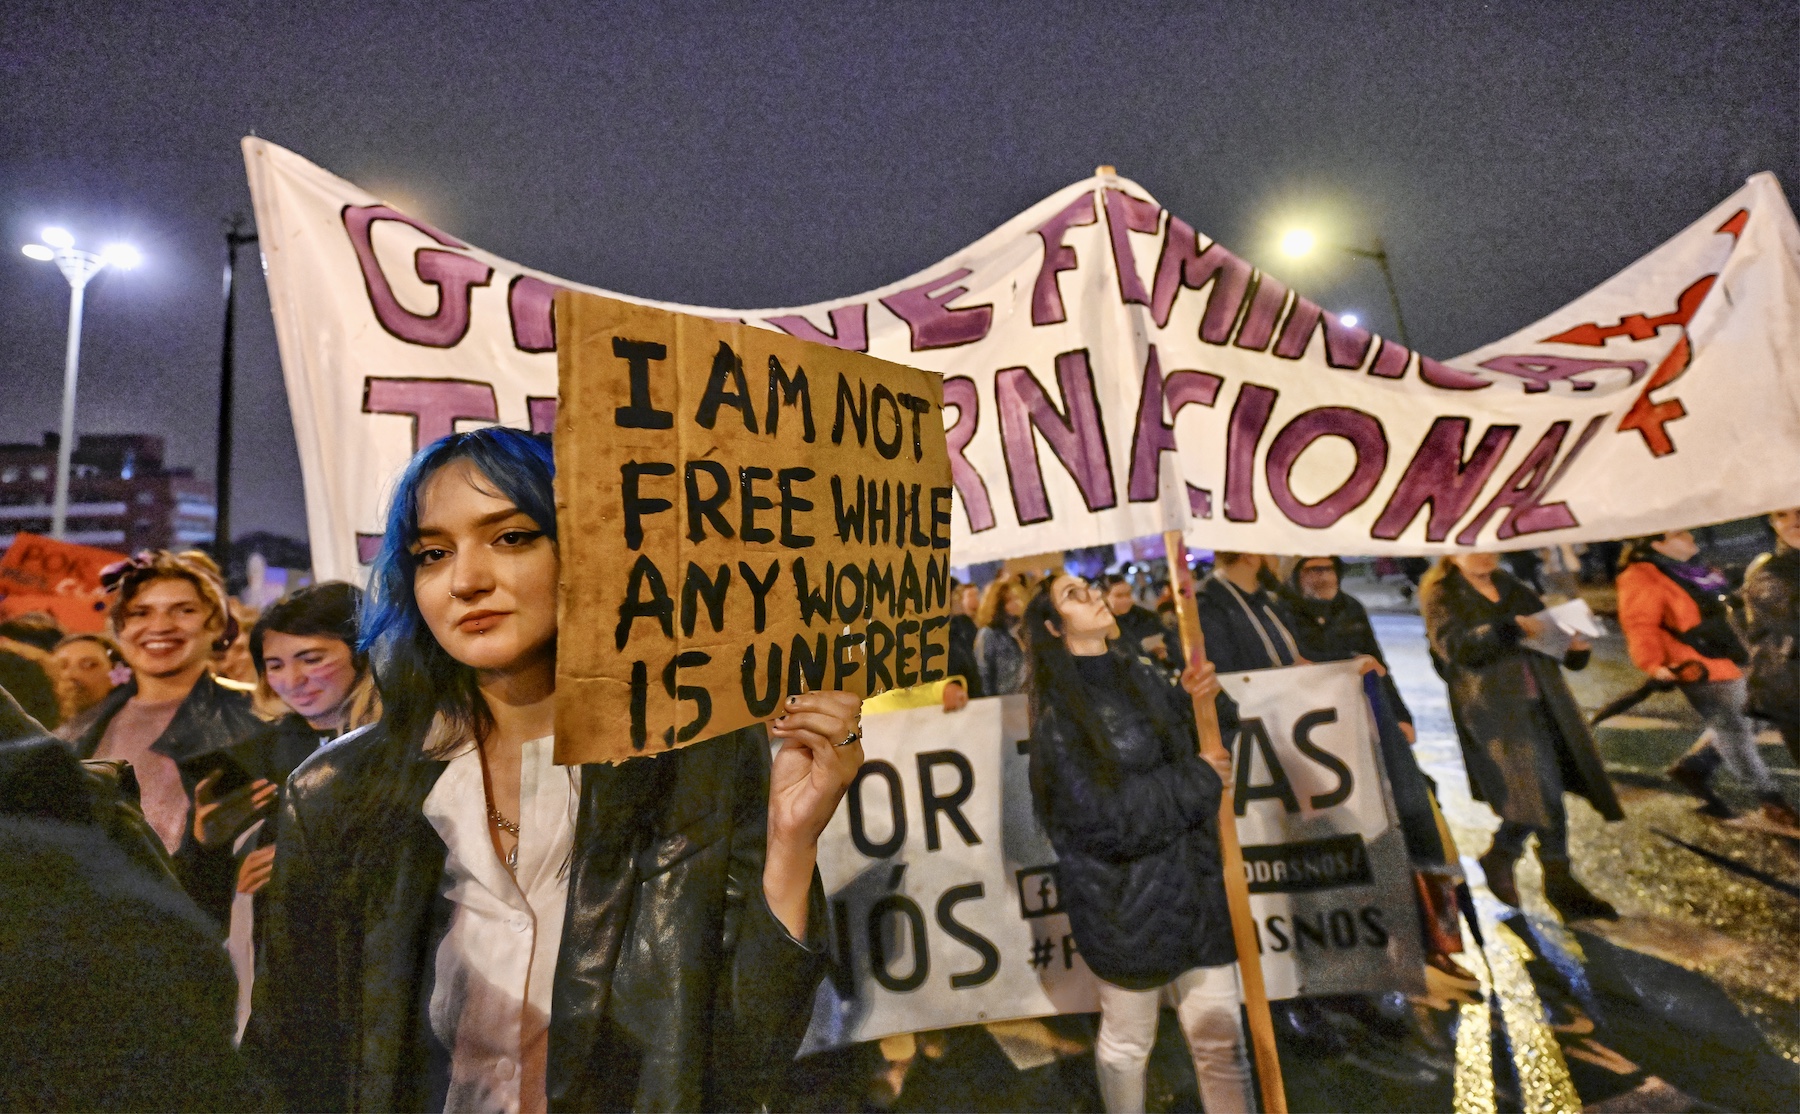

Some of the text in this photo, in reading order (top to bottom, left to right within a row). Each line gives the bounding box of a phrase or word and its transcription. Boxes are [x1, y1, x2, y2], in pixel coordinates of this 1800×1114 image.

[612, 336, 930, 463] I AM NOT
[620, 458, 953, 551] FREE WHILE
[615, 550, 949, 651] ANY WOMAN
[629, 616, 949, 751] IS UNFREE
[848, 749, 982, 859] OR
